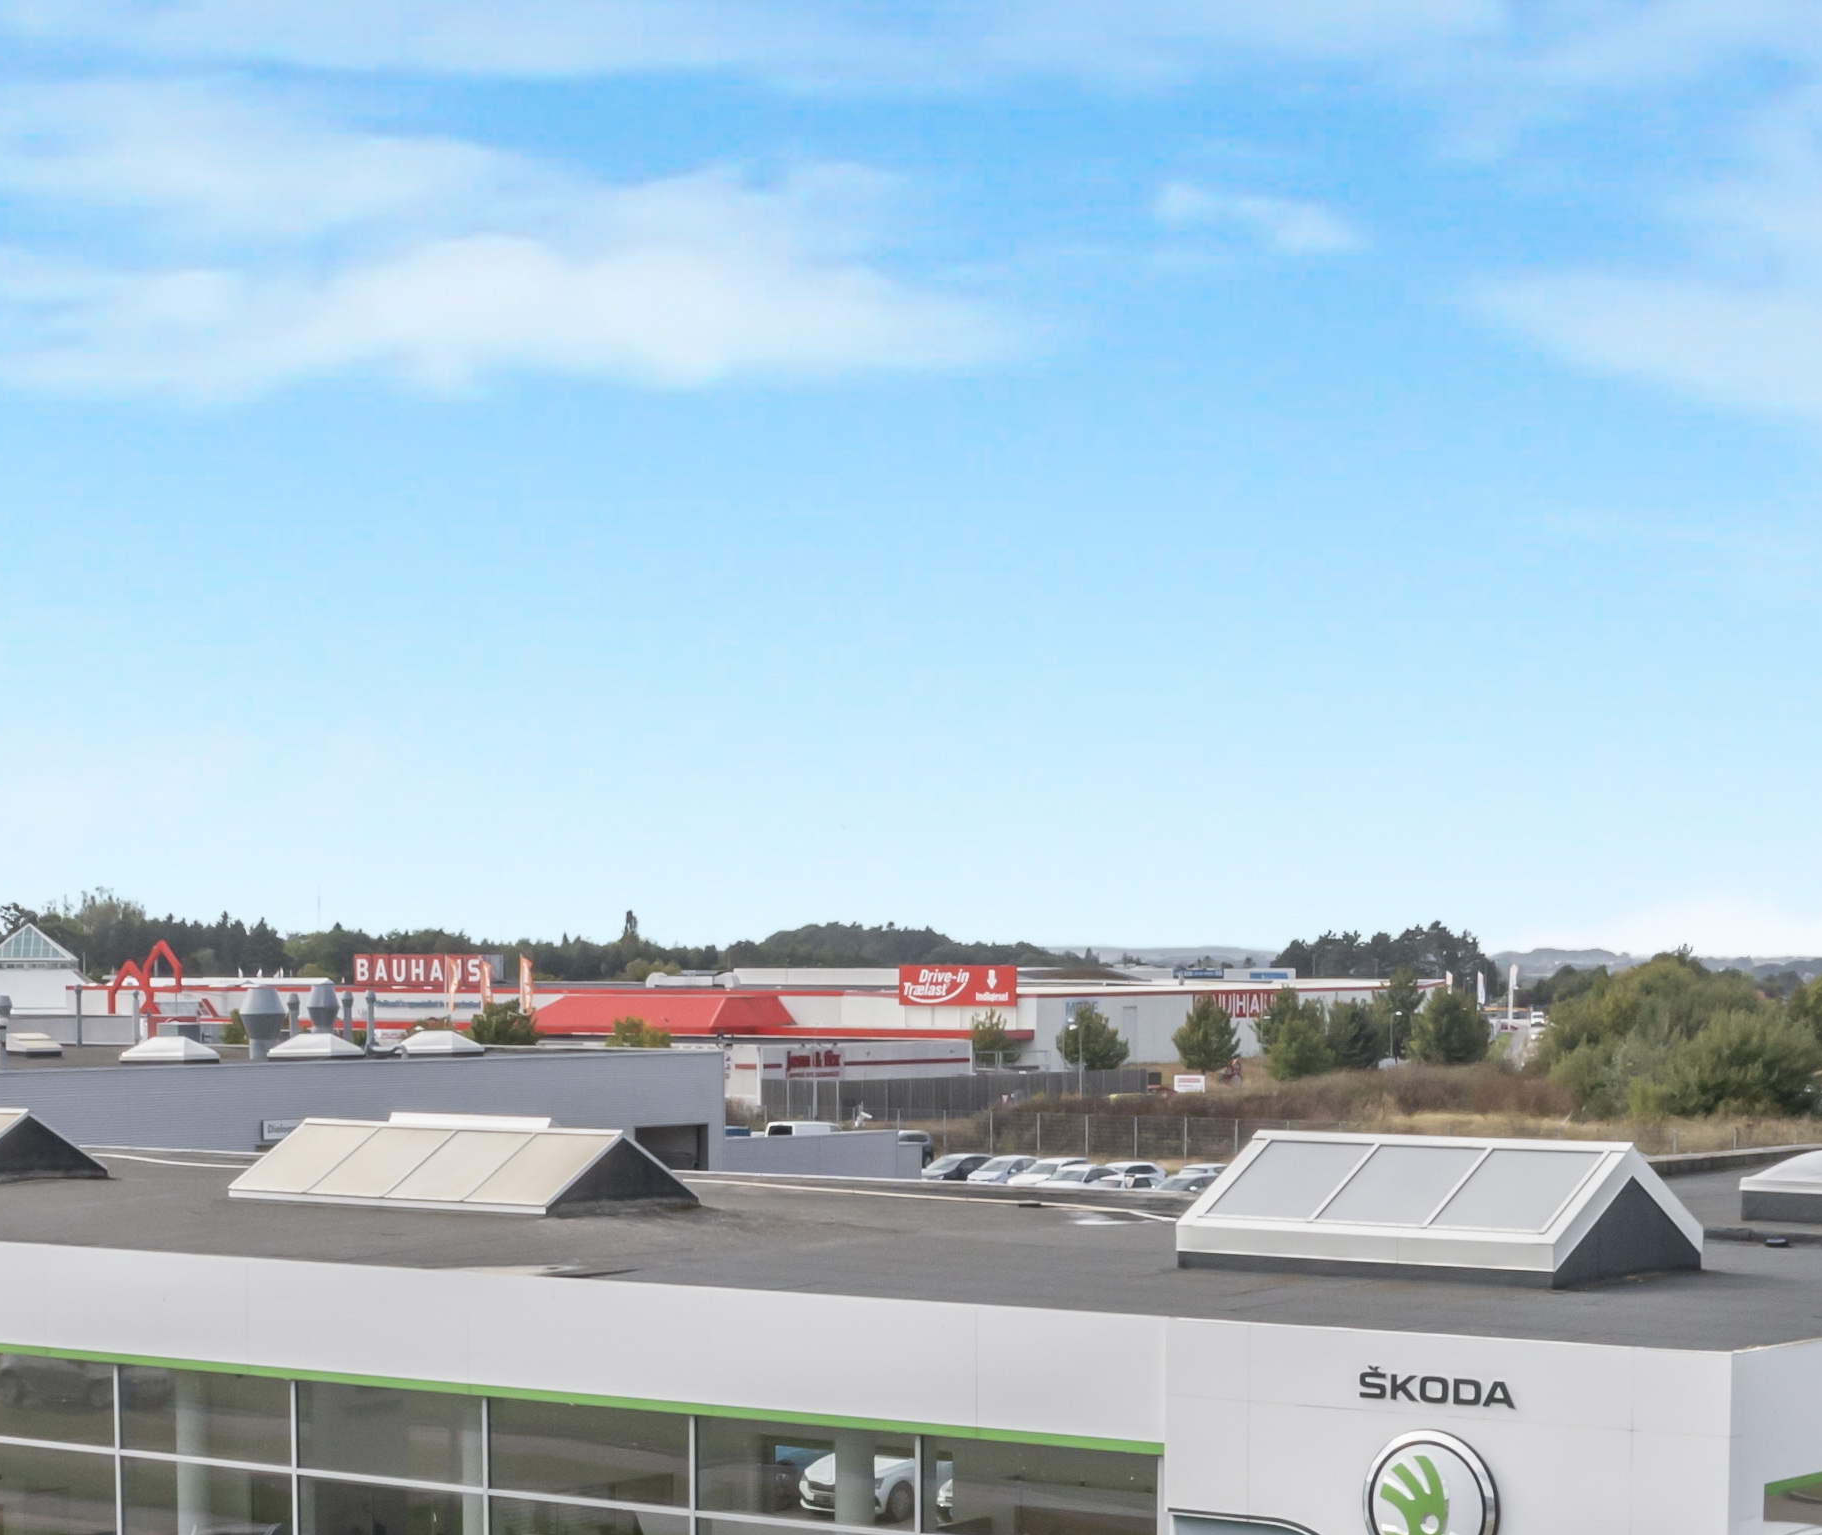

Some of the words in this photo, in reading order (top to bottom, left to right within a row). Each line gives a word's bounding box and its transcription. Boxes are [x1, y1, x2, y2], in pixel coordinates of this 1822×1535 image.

[356, 958, 480, 982] BAUHAS
[919, 969, 970, 983] Drive-in
[903, 982, 948, 996] Trælast
[1359, 1365, 1517, 1410] ŠKODA
